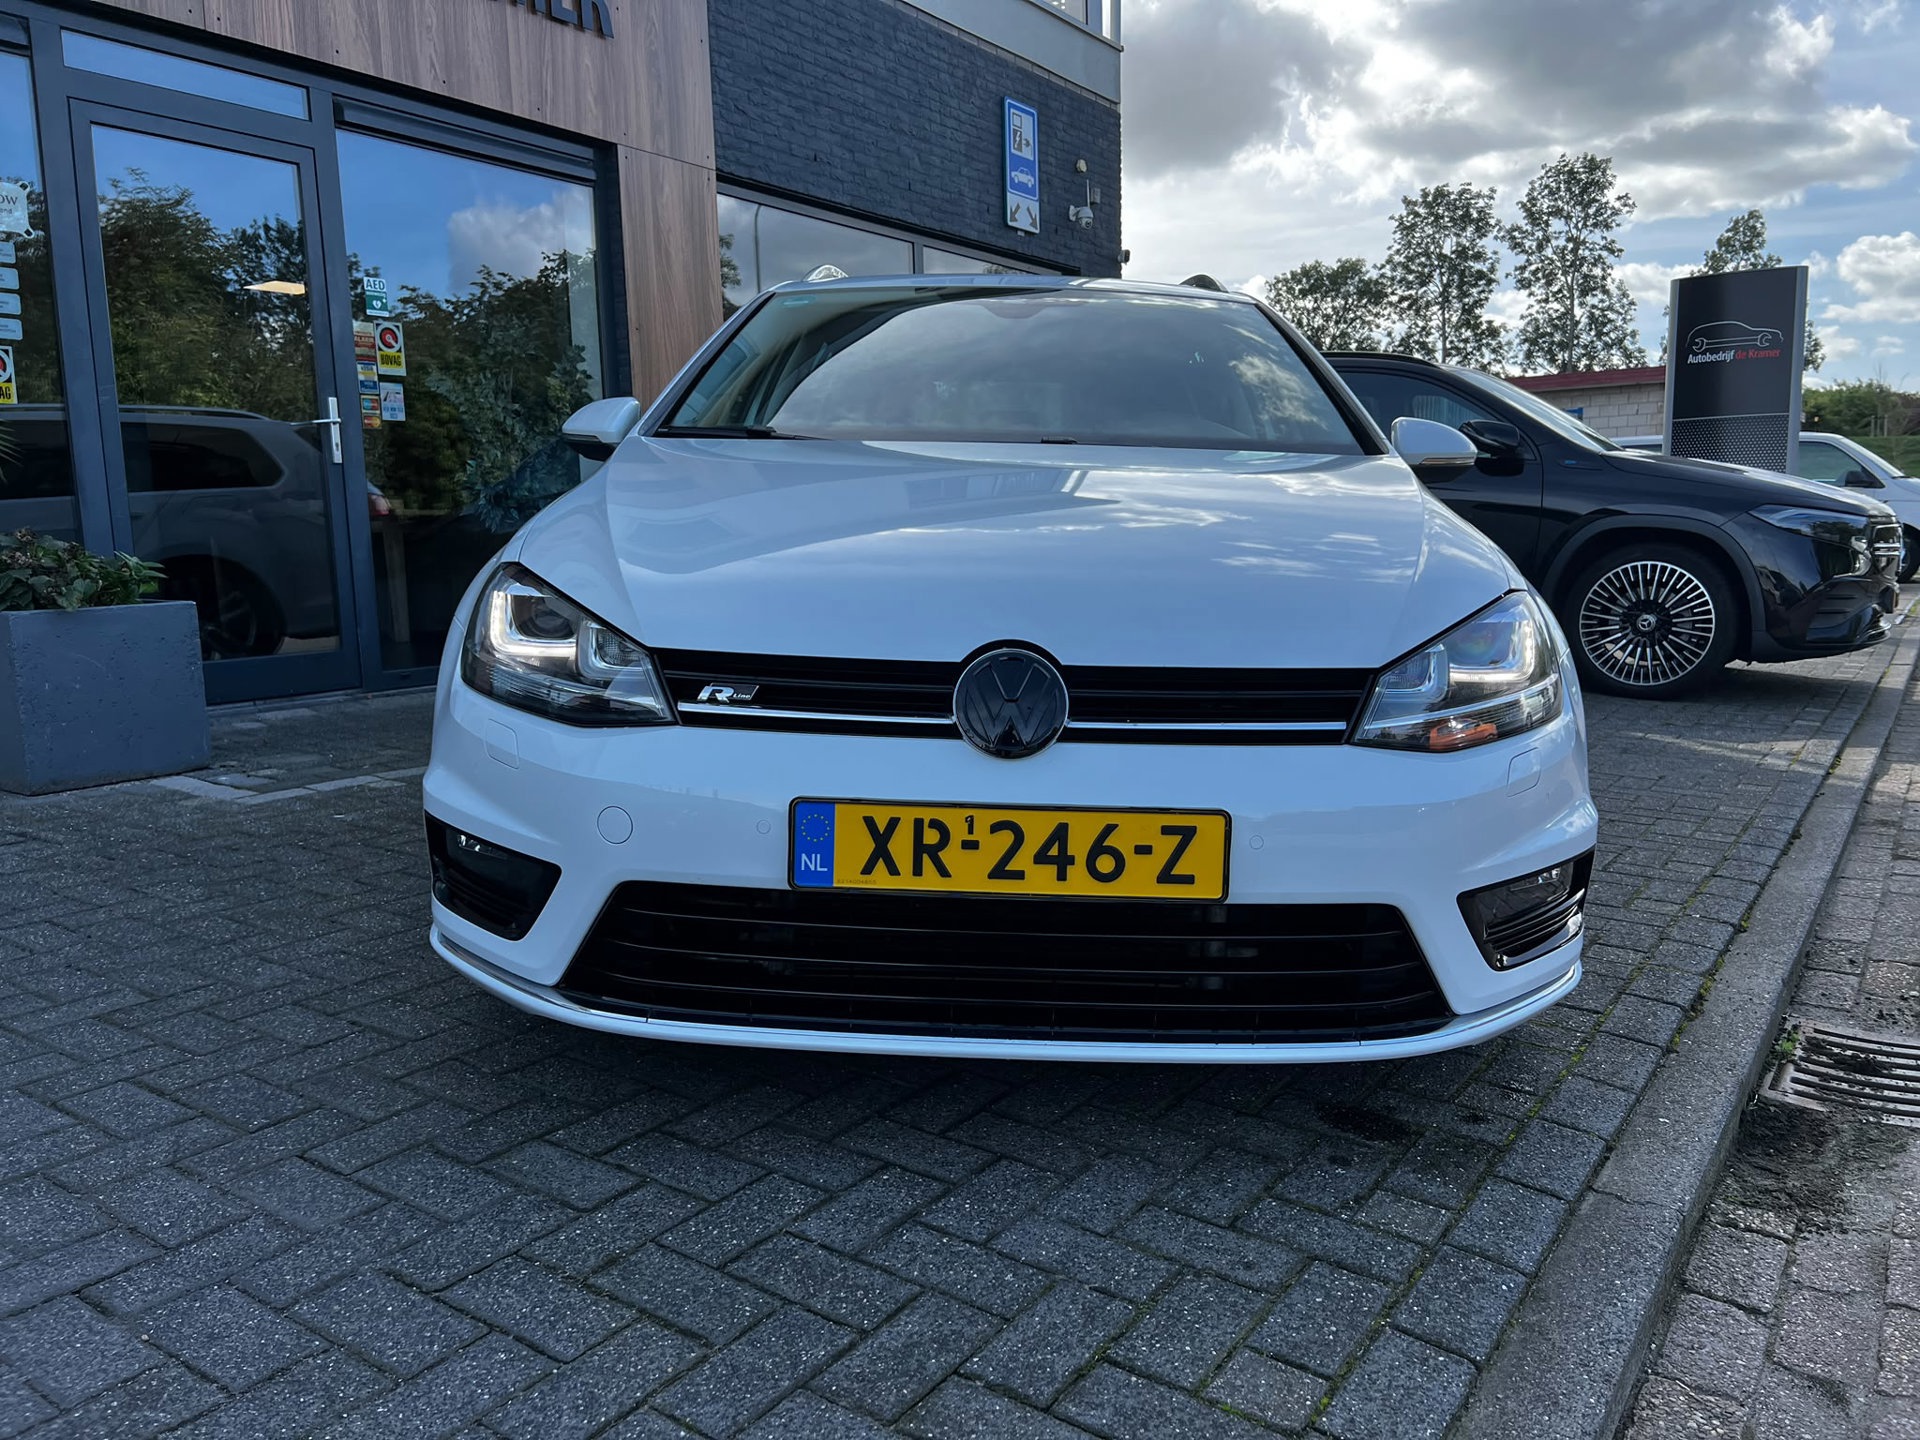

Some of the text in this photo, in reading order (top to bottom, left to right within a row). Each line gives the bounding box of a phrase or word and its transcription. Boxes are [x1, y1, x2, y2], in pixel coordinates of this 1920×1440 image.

[365, 278, 386, 291] AED
[380, 353, 402, 367] BOVAG
[1687, 348, 1781, 364] Autobedrijf de Kramer
[697, 685, 735, 703] R
[801, 853, 829, 872] NL
